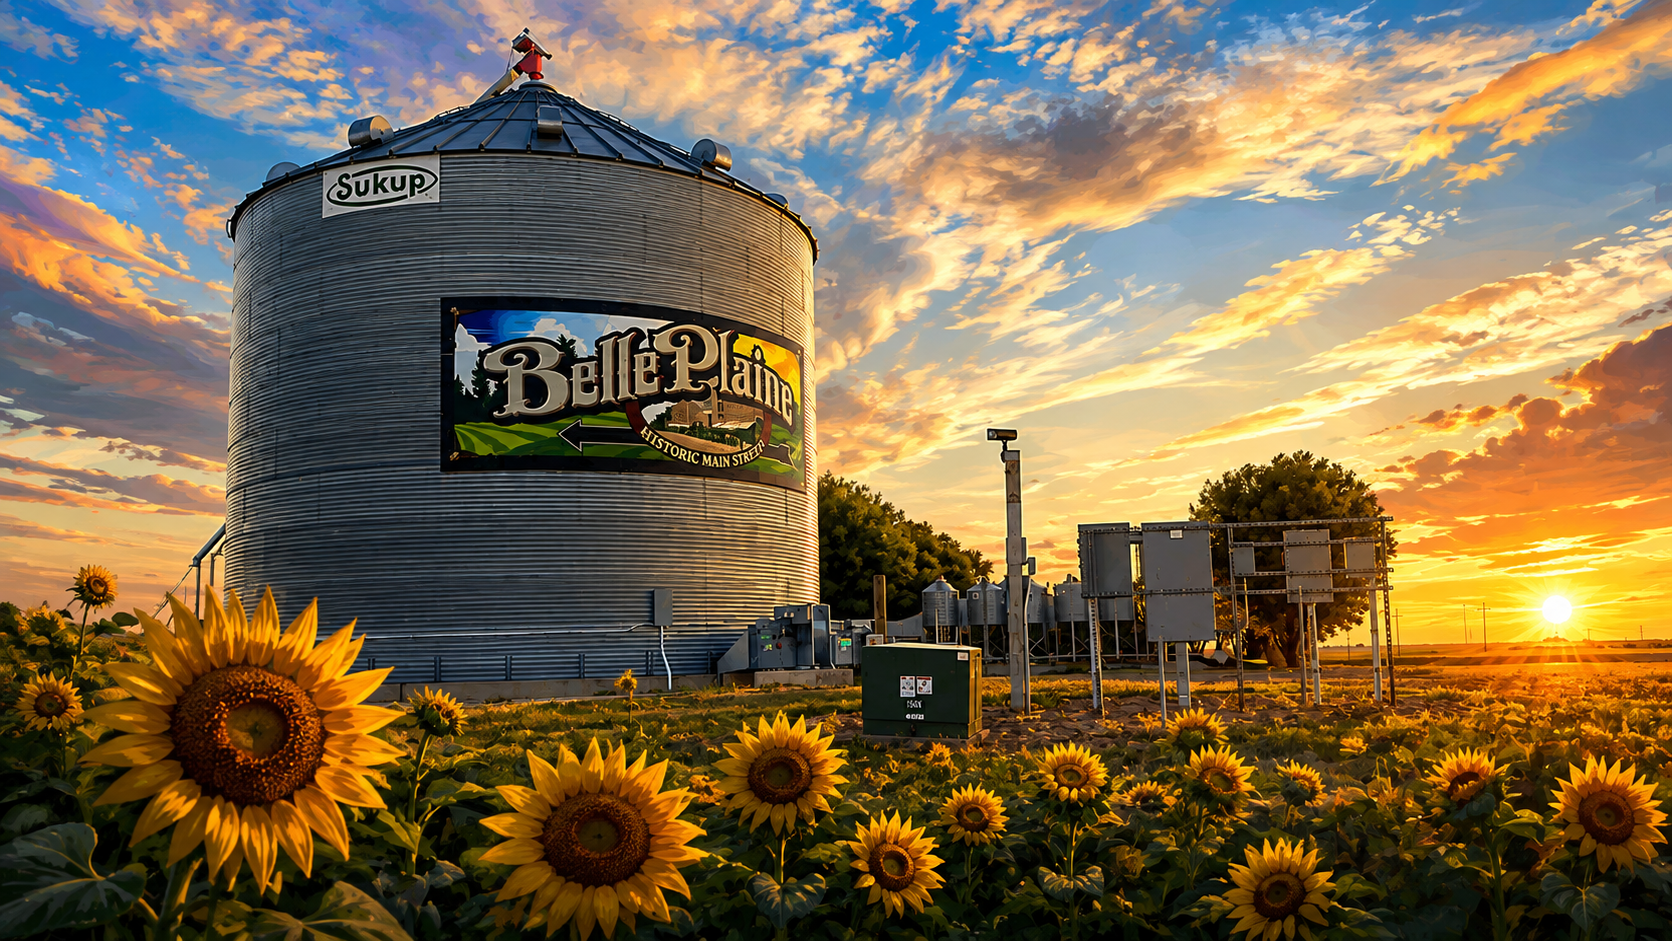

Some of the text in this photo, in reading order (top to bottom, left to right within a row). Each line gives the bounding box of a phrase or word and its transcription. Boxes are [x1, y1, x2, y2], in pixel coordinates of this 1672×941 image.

[336, 172, 426, 201] Sukup
[483, 323, 794, 427] Belle Plaine
[640, 426, 700, 465] HISTORIC
[702, 453, 731, 468] MAIN
